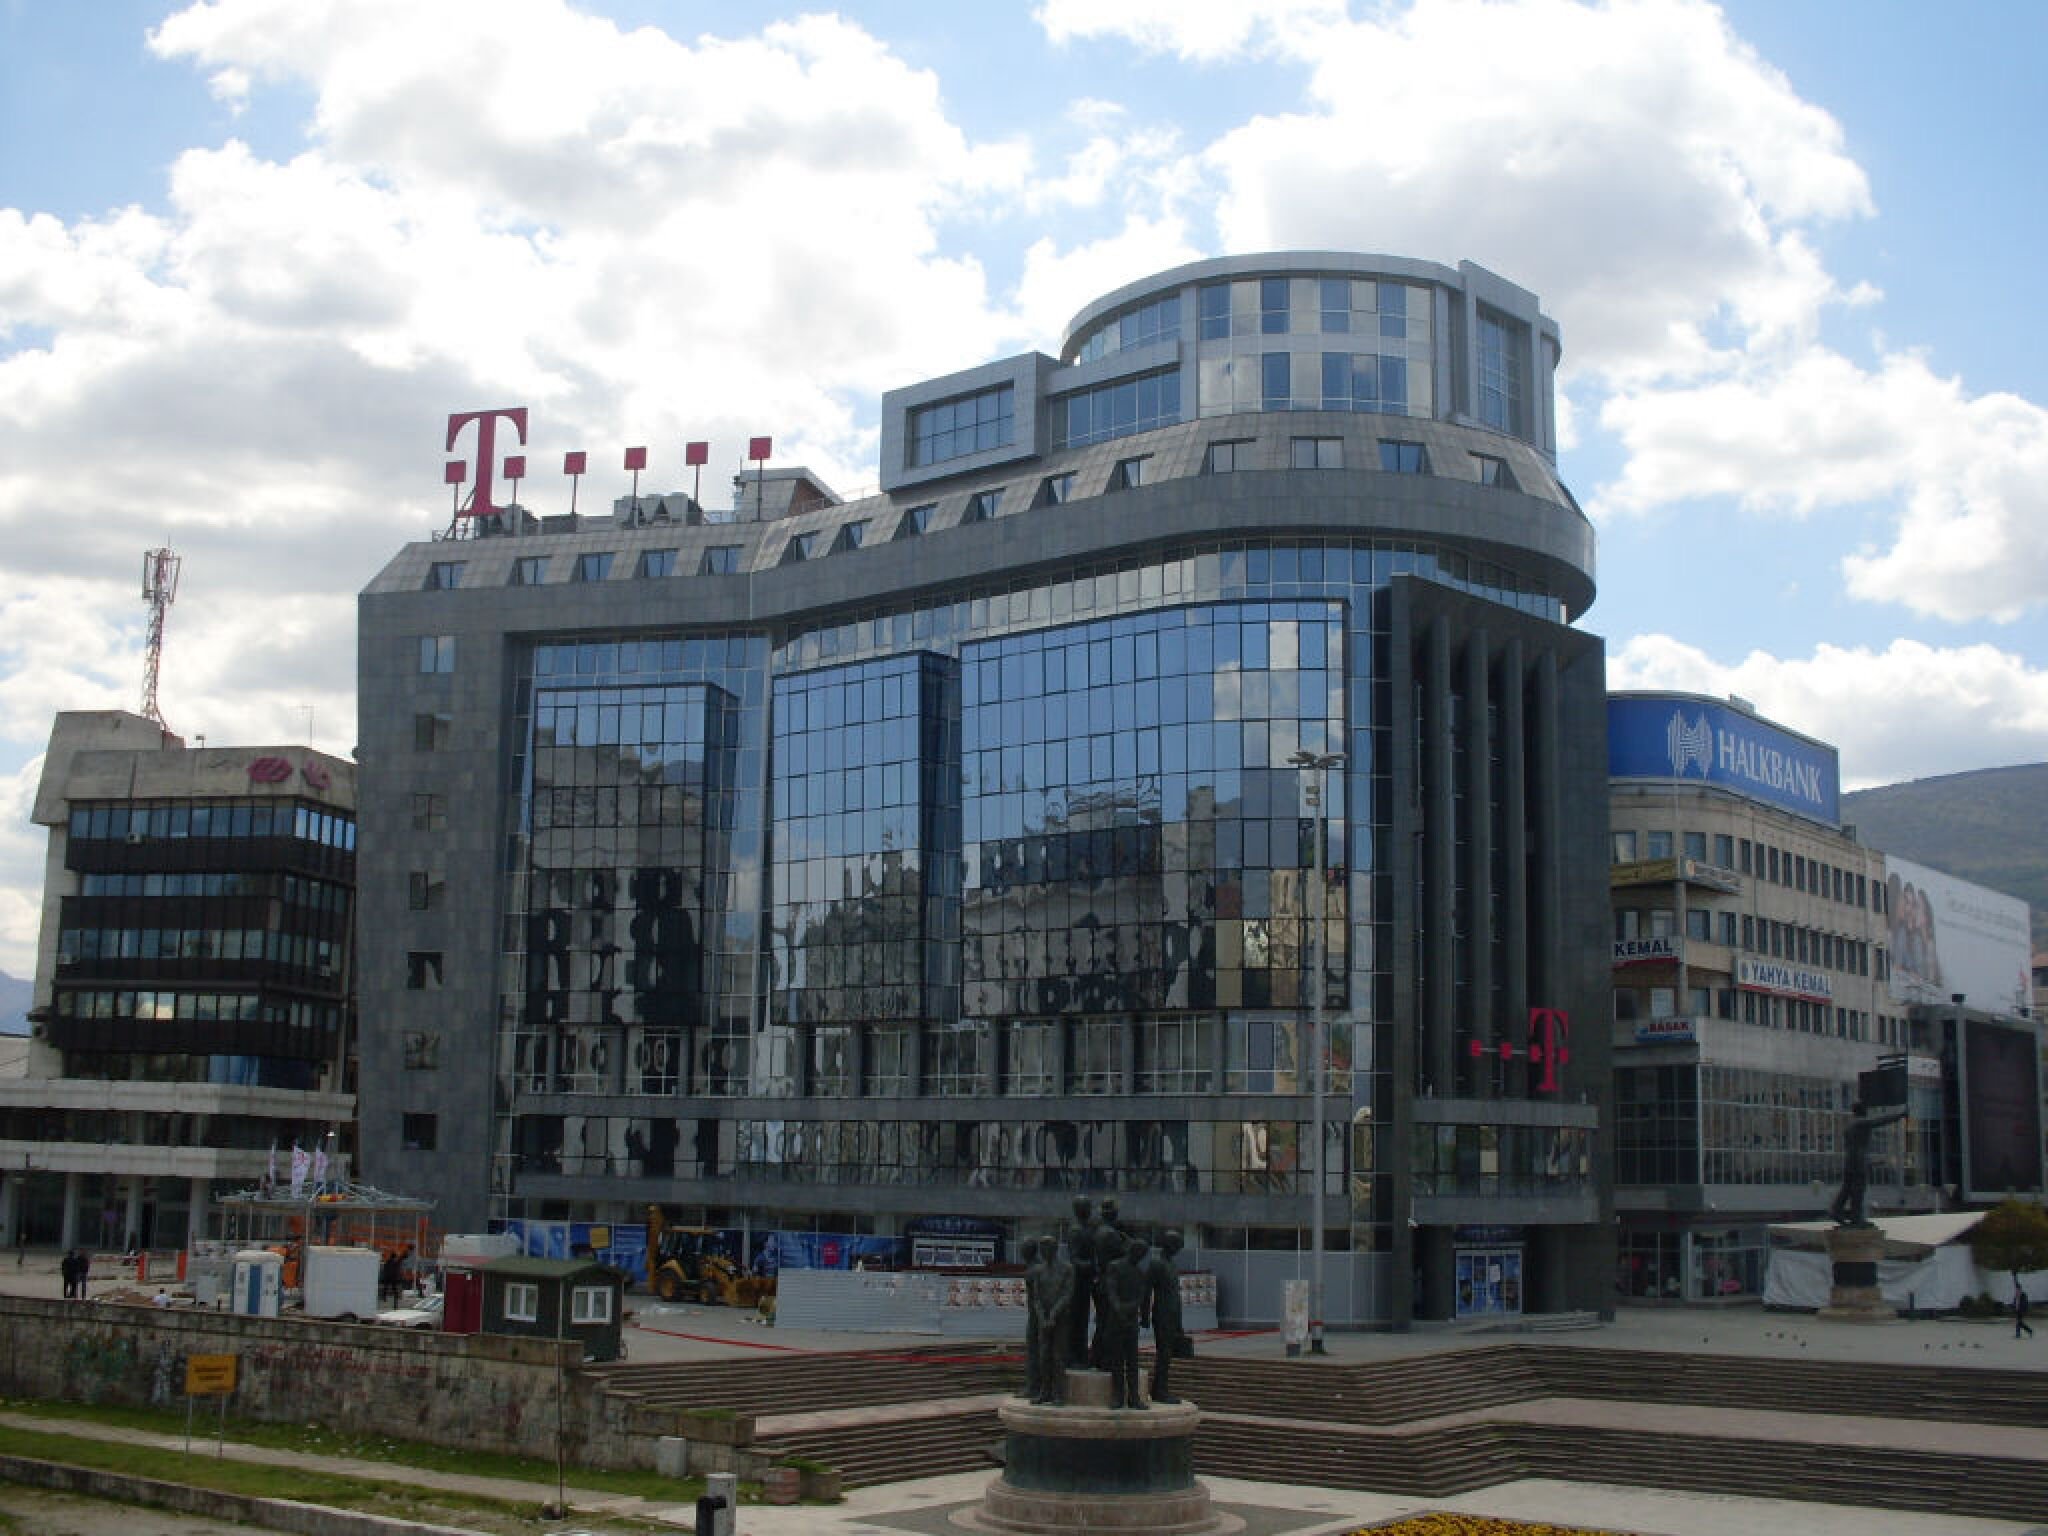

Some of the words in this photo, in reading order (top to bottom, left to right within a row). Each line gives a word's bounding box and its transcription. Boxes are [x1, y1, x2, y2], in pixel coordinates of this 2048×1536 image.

[446, 407, 528, 518] T
[1719, 728, 1823, 804] HALKBANK
[1615, 938, 1673, 957] KEMAL
[1752, 961, 1791, 985] YAHYA
[1793, 970, 1831, 994] KEMAL
[1529, 1007, 1568, 1091] T
